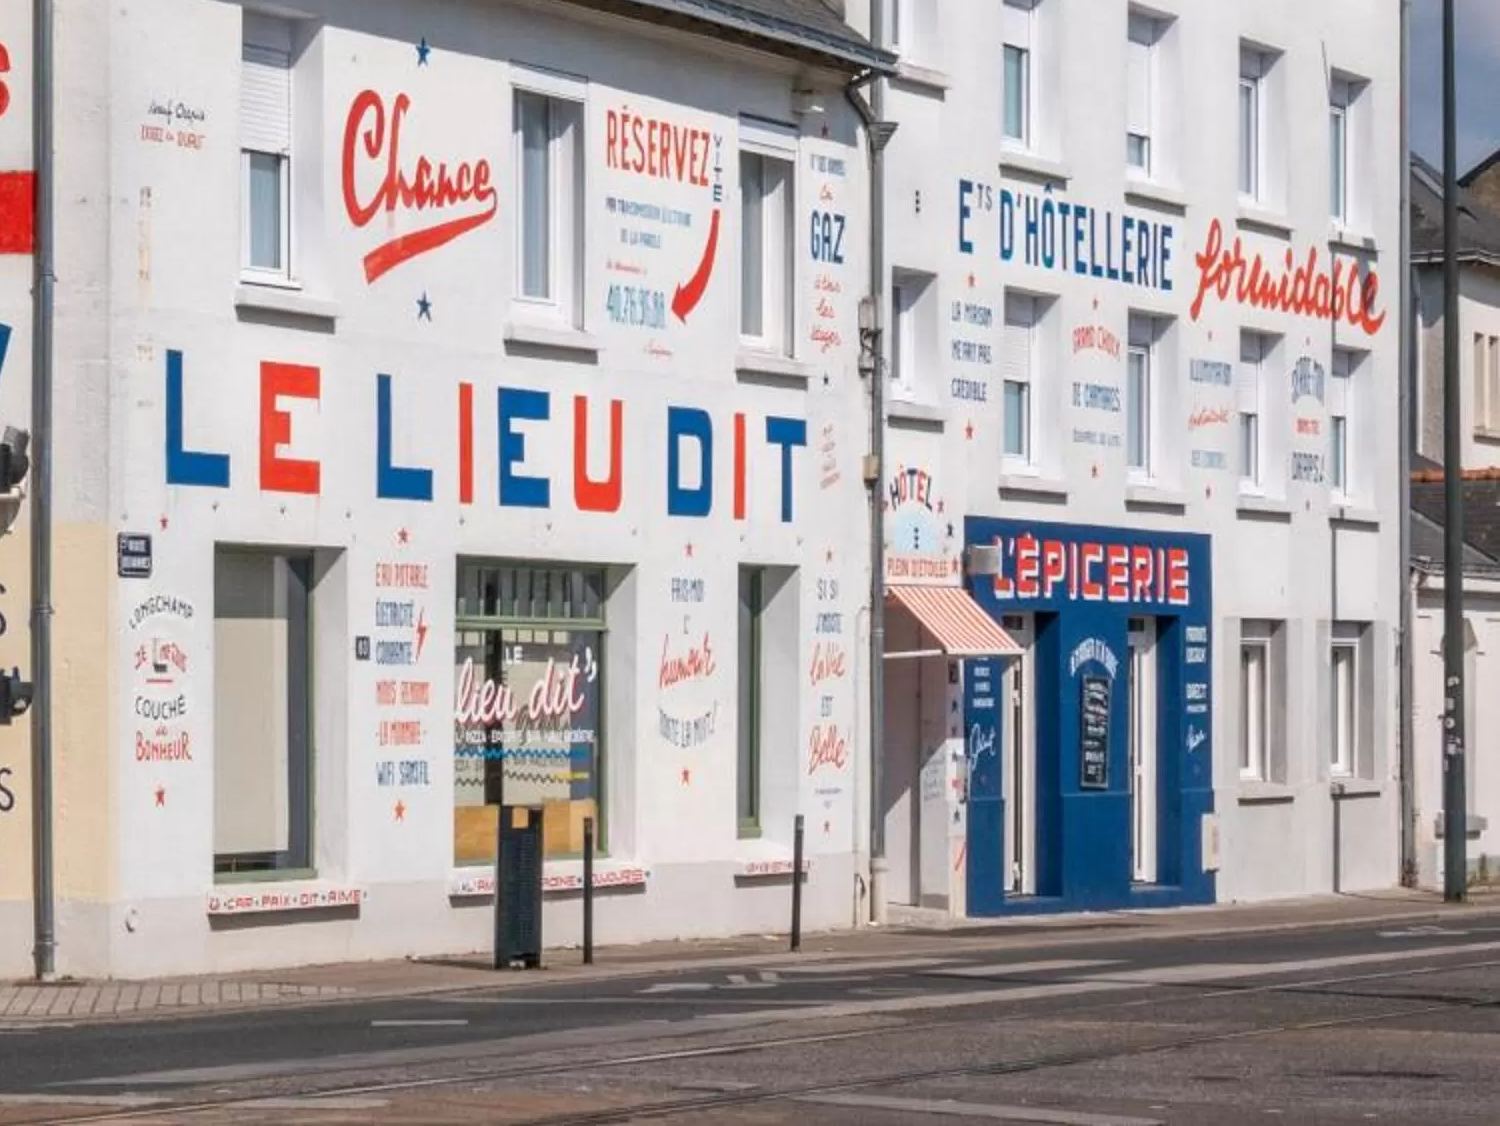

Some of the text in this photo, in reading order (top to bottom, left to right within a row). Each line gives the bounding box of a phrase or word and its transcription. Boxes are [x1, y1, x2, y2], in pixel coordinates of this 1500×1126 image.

[342, 89, 497, 228] Chance
[607, 105, 710, 186] RÉSERVEZ
[811, 210, 846, 264] GAZ
[1000, 182, 1173, 291] D'HÔTELLERIE
[166, 349, 321, 495] LE
[376, 373, 622, 514] LIEU
[667, 405, 807, 523] DIT
[890, 466, 932, 511] HÔTEL
[994, 532, 1189, 606] L'ÉPICERIE
[455, 656, 518, 724] lieu
[505, 646, 523, 665] LE
[135, 694, 186, 721] COUCHÉ
